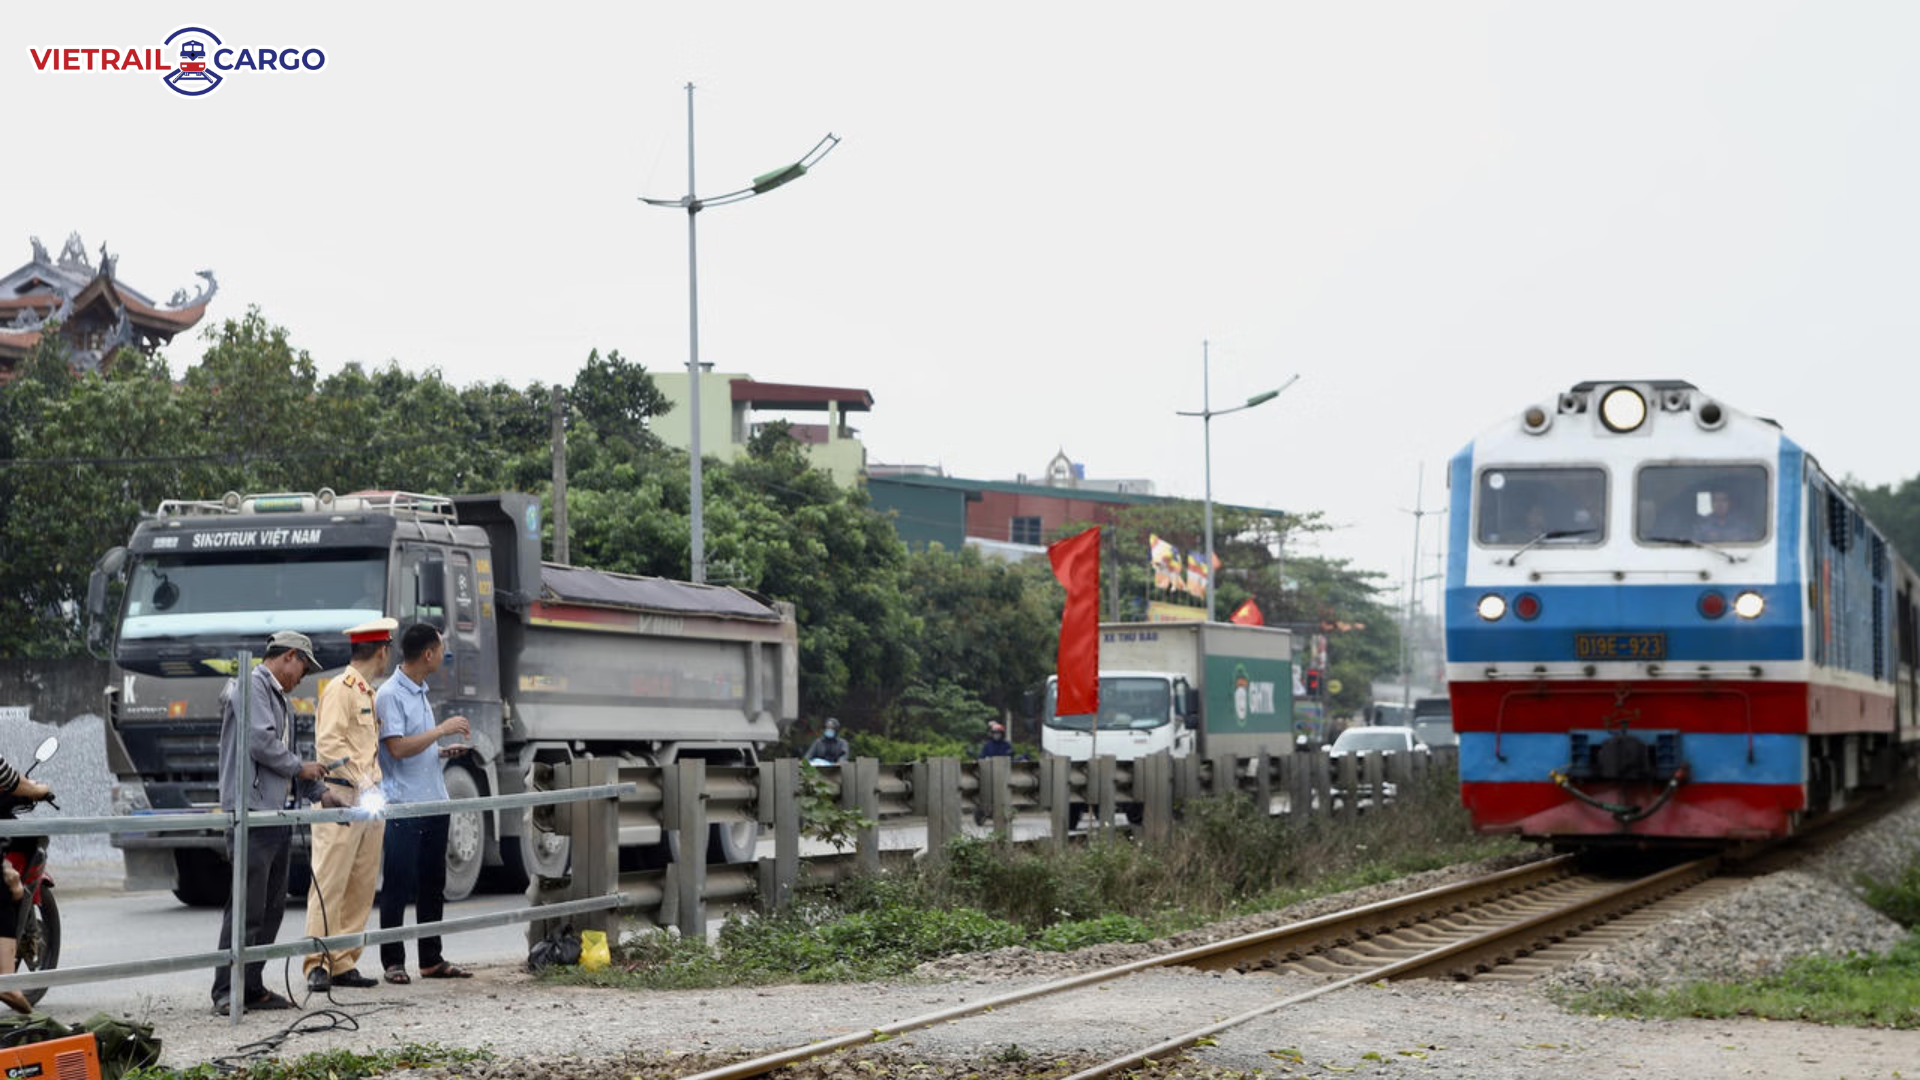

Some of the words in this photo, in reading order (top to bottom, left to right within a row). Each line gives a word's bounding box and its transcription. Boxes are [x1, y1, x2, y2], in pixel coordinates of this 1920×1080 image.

[192, 531, 257, 548] SINOTRUK
[291, 529, 321, 544] NAM
[1580, 635, 1660, 656] D19E-923
